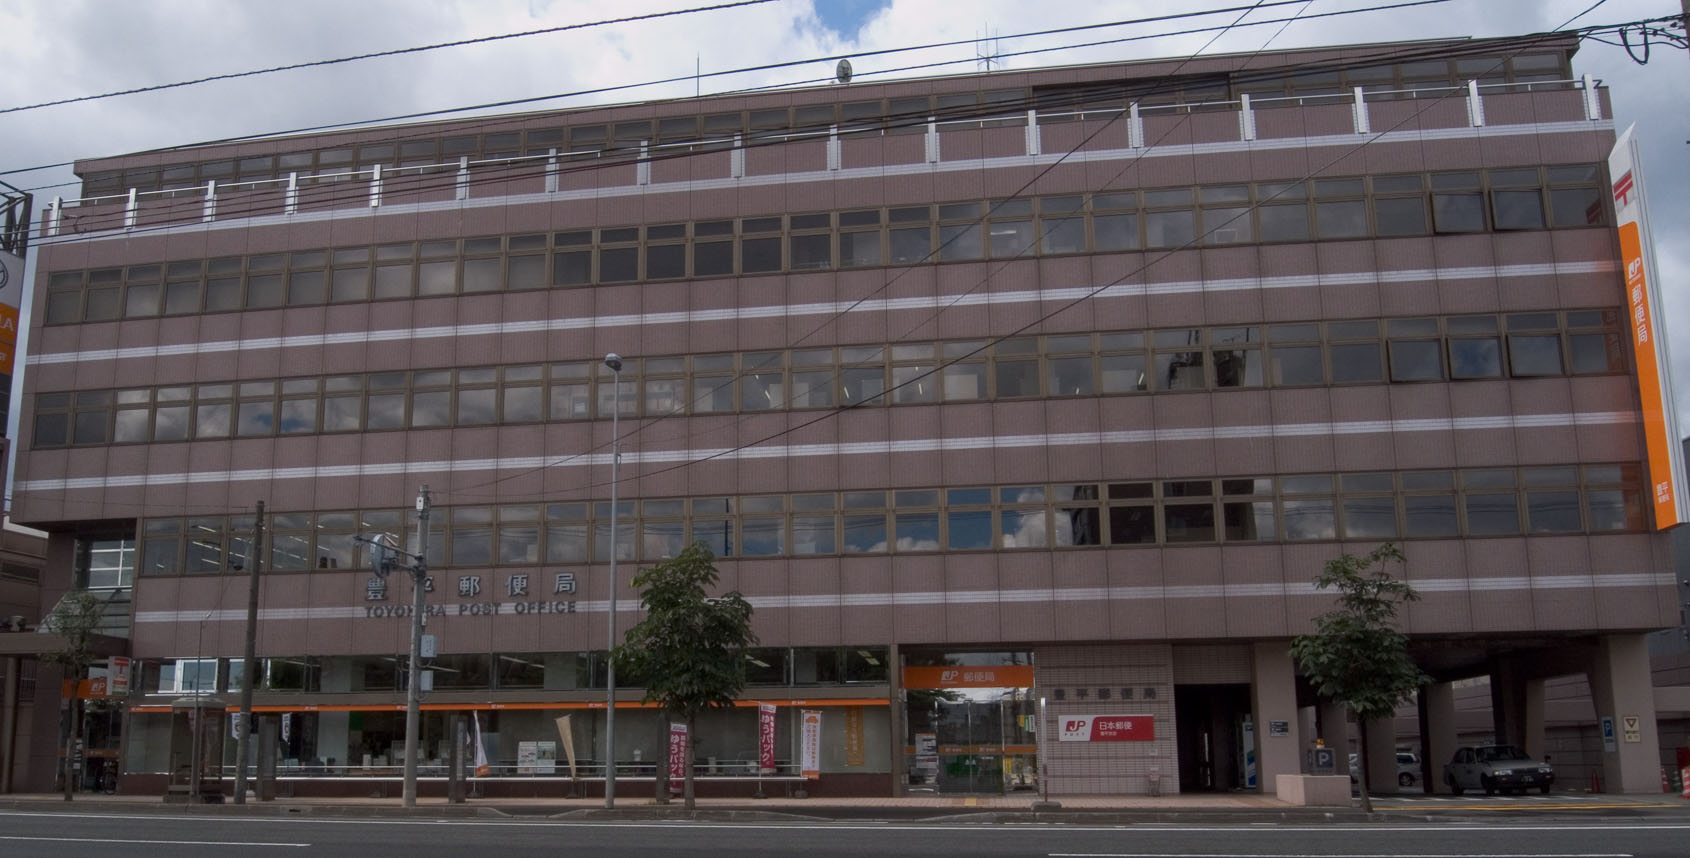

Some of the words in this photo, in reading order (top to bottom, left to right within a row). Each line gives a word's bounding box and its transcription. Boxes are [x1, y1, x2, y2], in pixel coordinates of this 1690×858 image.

[1632, 283, 1648, 347] 郵便局
[459, 602, 501, 616] POST
[515, 600, 576, 615] OFFICE
[1065, 720, 1086, 732] JP
[1099, 721, 1133, 730] 日本郵便
[761, 714, 770, 762] ゆうパック
[1318, 752, 1329, 766] P
